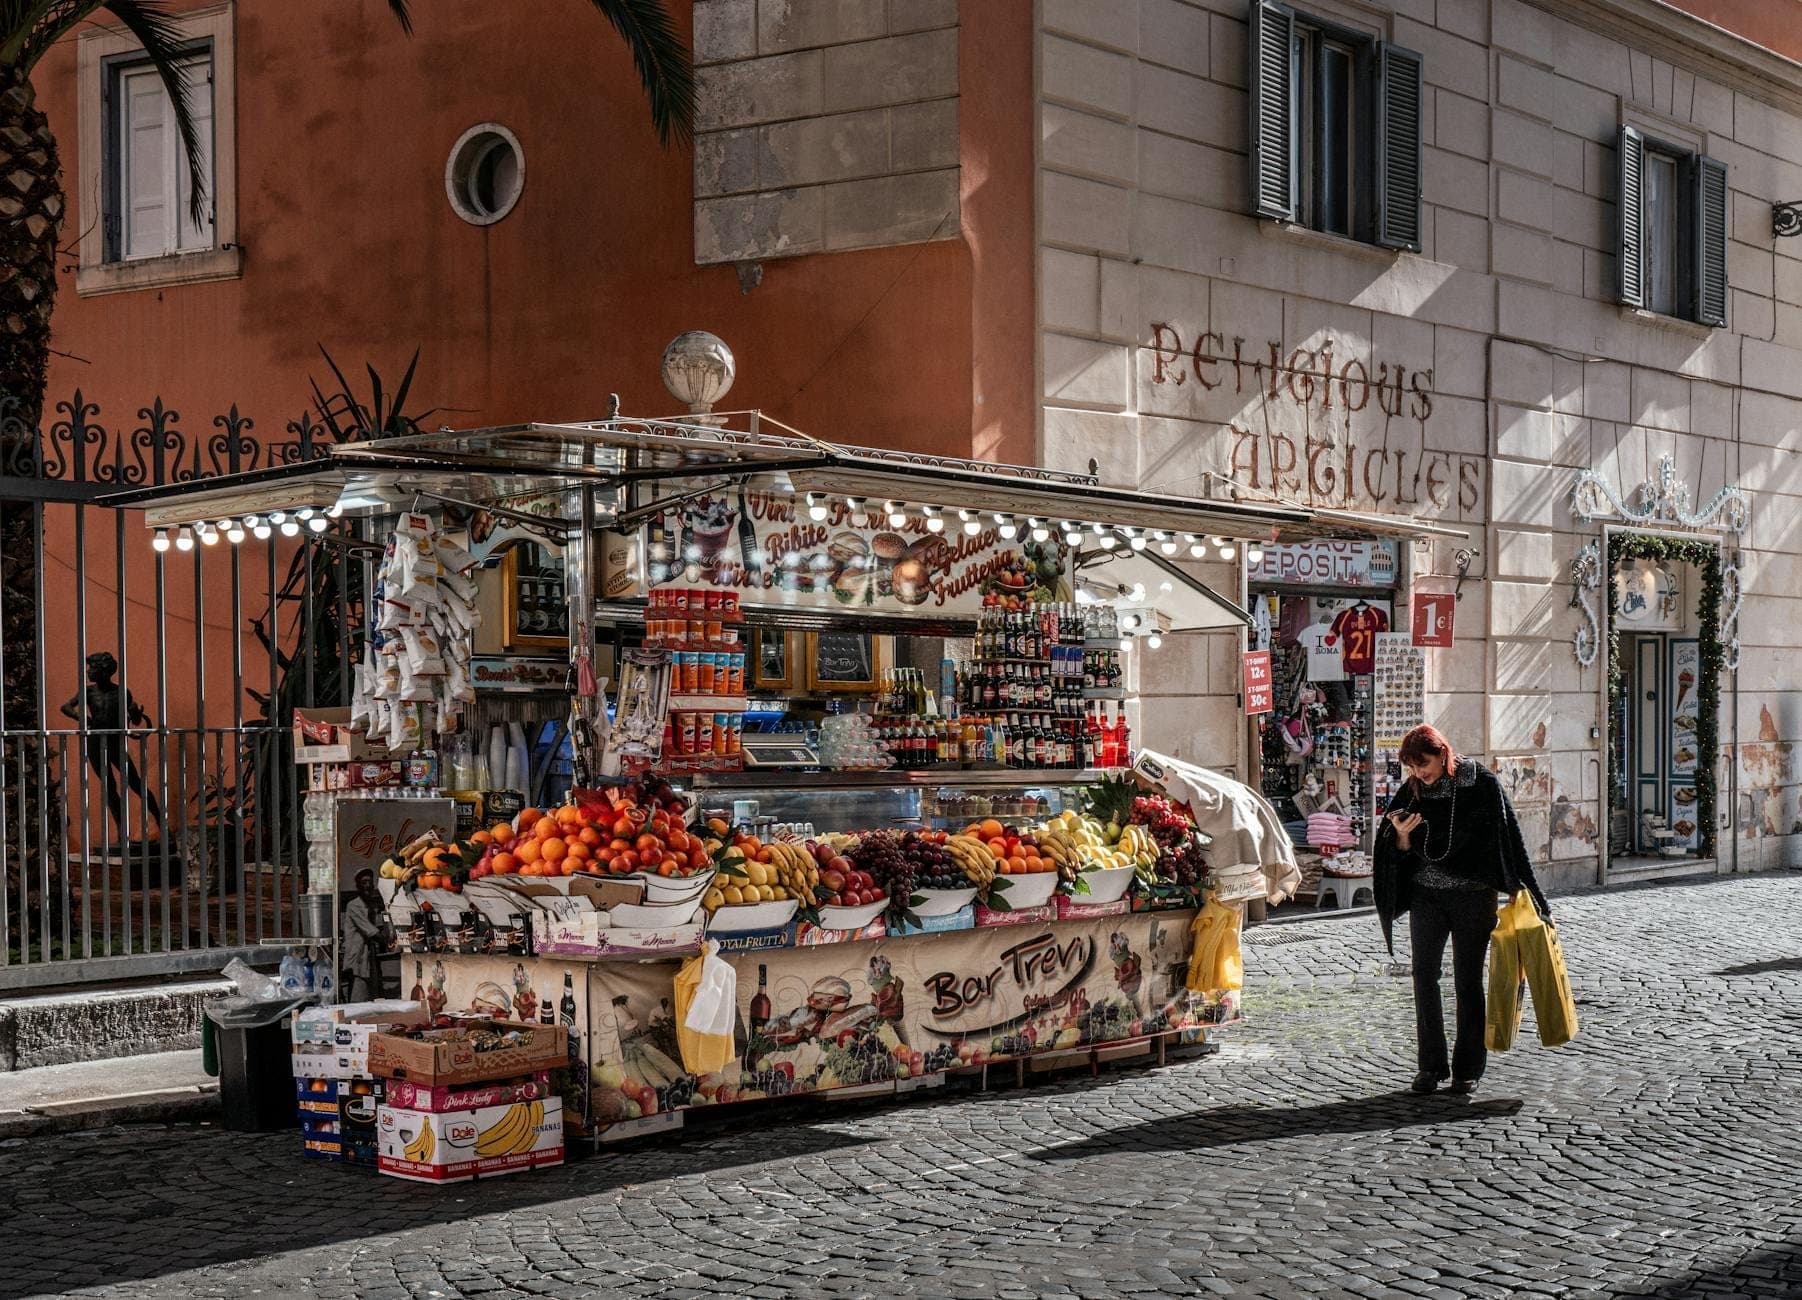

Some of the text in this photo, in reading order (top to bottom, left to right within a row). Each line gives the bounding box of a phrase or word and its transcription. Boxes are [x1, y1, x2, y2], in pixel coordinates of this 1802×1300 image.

[750, 491, 796, 523] Vini
[765, 523, 829, 565] Bibite
[930, 549, 1013, 607] Frutteria
[1315, 647, 1340, 655] ROMA
[1350, 629, 1372, 660] 21
[350, 818, 447, 858] Gela
[719, 931, 789, 949] OYALFRUTTA
[923, 932, 1085, 1019] Bar Trevi
[454, 1051, 473, 1064] Dole
[444, 1092, 494, 1110] Pink Lady
[452, 1125, 475, 1140] Dole
[532, 1122, 561, 1134] BANANAS
